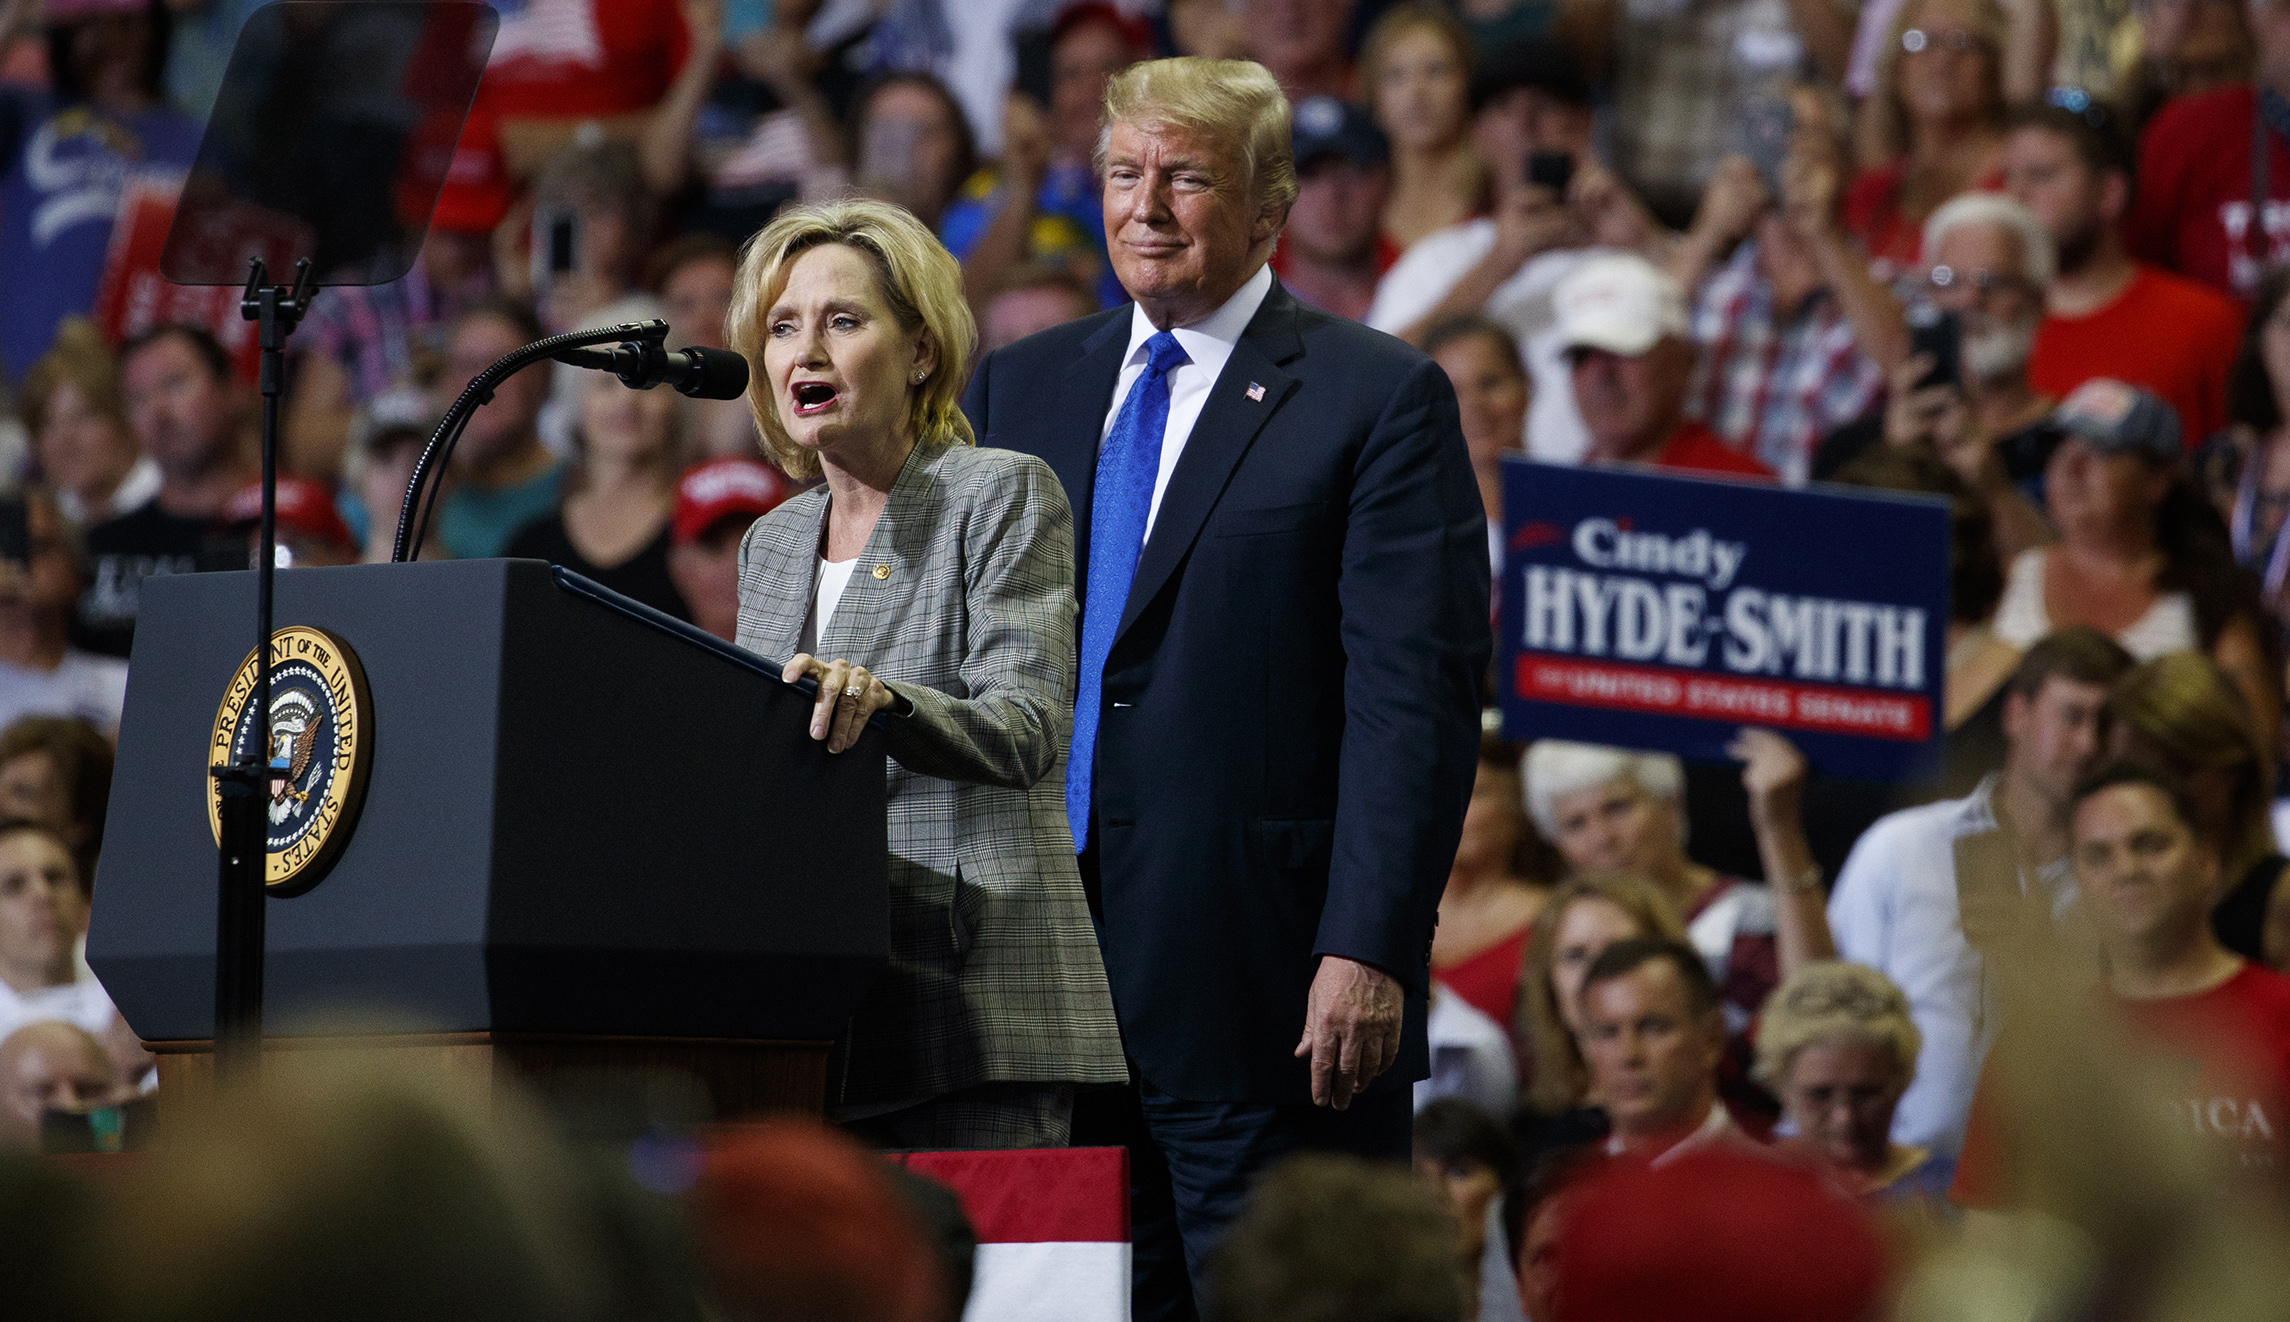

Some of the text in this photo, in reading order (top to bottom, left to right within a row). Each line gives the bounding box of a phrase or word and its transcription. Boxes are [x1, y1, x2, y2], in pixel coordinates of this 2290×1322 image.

[1571, 515, 1746, 591] Cindy
[297, 638, 312, 654] OF
[313, 643, 331, 668] THE
[1523, 563, 1927, 690] HYDE-SMITH
[215, 635, 294, 749] PRESIDNT
[330, 665, 353, 771] UNITED
[1567, 668, 1682, 706] UNITED
[1685, 678, 1791, 718] STATES
[1796, 689, 1912, 733] SENATE
[282, 795, 339, 873] STATES
